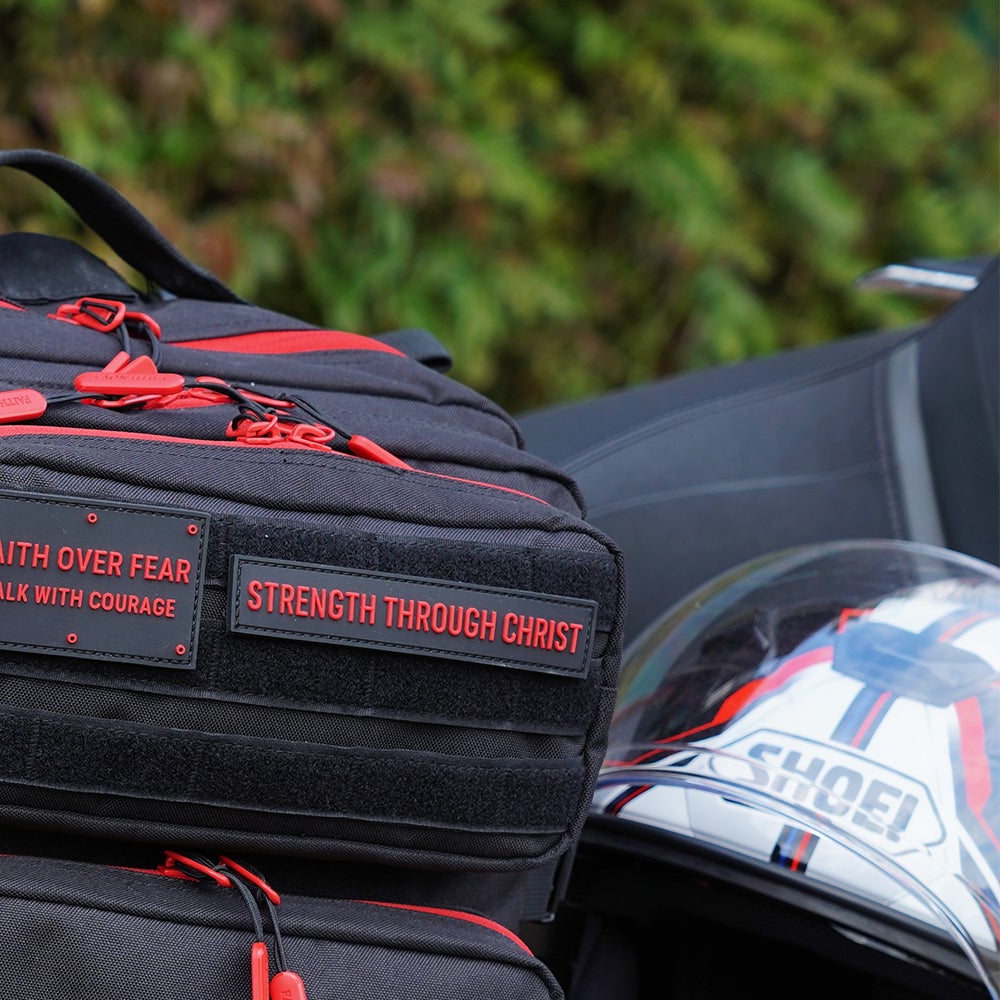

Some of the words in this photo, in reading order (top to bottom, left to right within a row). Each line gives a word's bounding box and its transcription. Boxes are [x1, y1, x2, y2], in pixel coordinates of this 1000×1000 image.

[0, 395, 33, 407] FAITH
[56, 546, 124, 576] OVER
[129, 553, 191, 584] FEAR
[34, 585, 84, 608] WITH
[87, 591, 176, 618] COURAGE
[247, 580, 377, 625] STRENGTH
[383, 596, 498, 642] THROUGH
[501, 612, 583, 653] CHRIST
[737, 743, 919, 843] SHOEI
